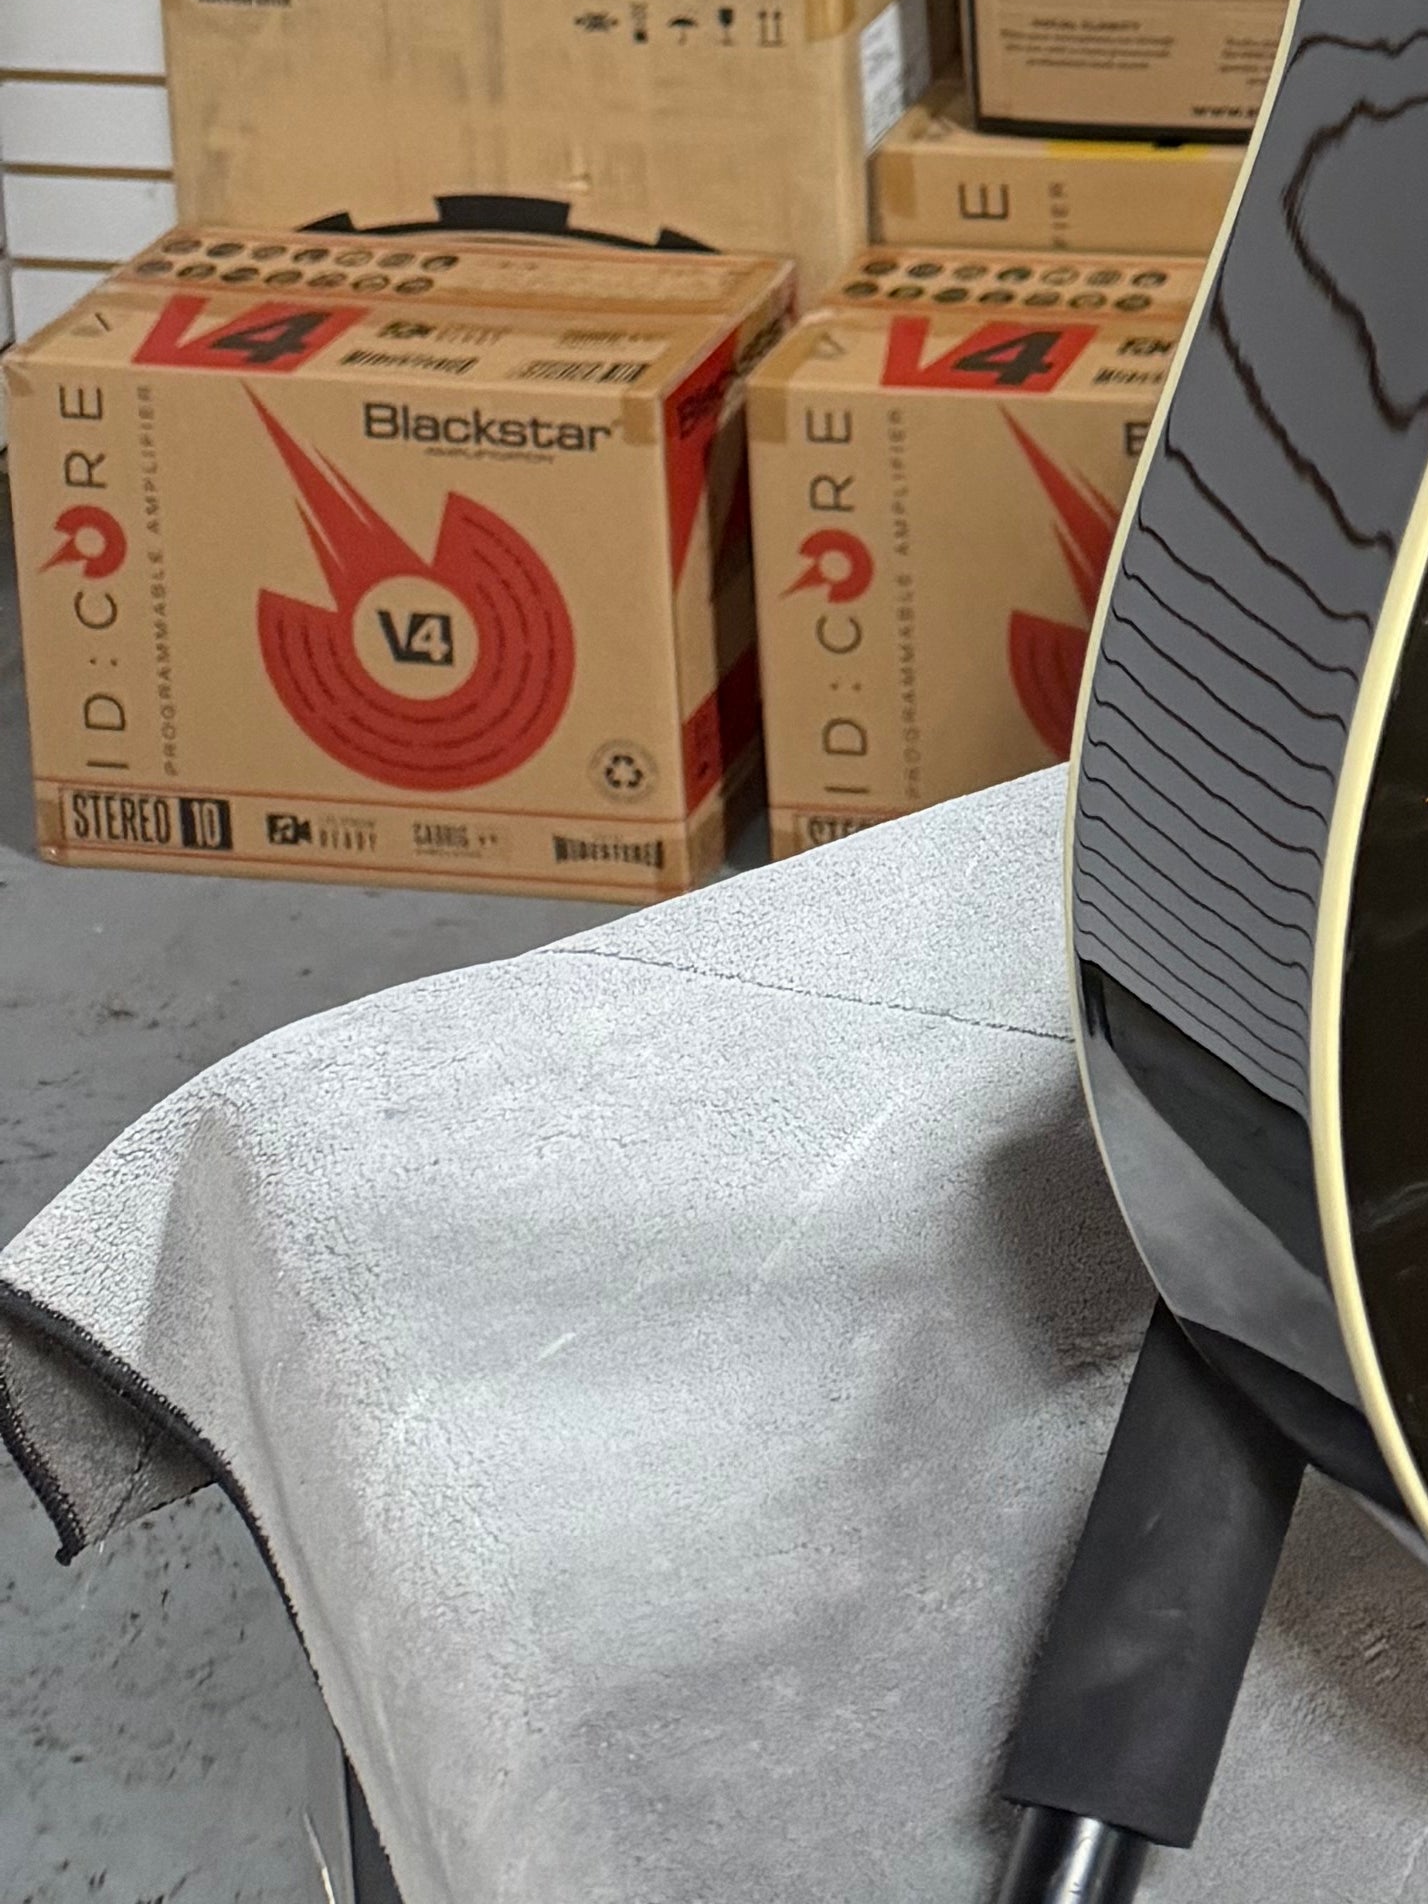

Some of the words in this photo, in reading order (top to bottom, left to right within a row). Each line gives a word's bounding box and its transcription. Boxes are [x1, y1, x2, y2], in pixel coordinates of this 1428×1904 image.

[362, 401, 612, 451] Blackstar
[378, 611, 454, 666] V4
[71, 792, 171, 845] STEREO
[187, 799, 225, 848] 10
